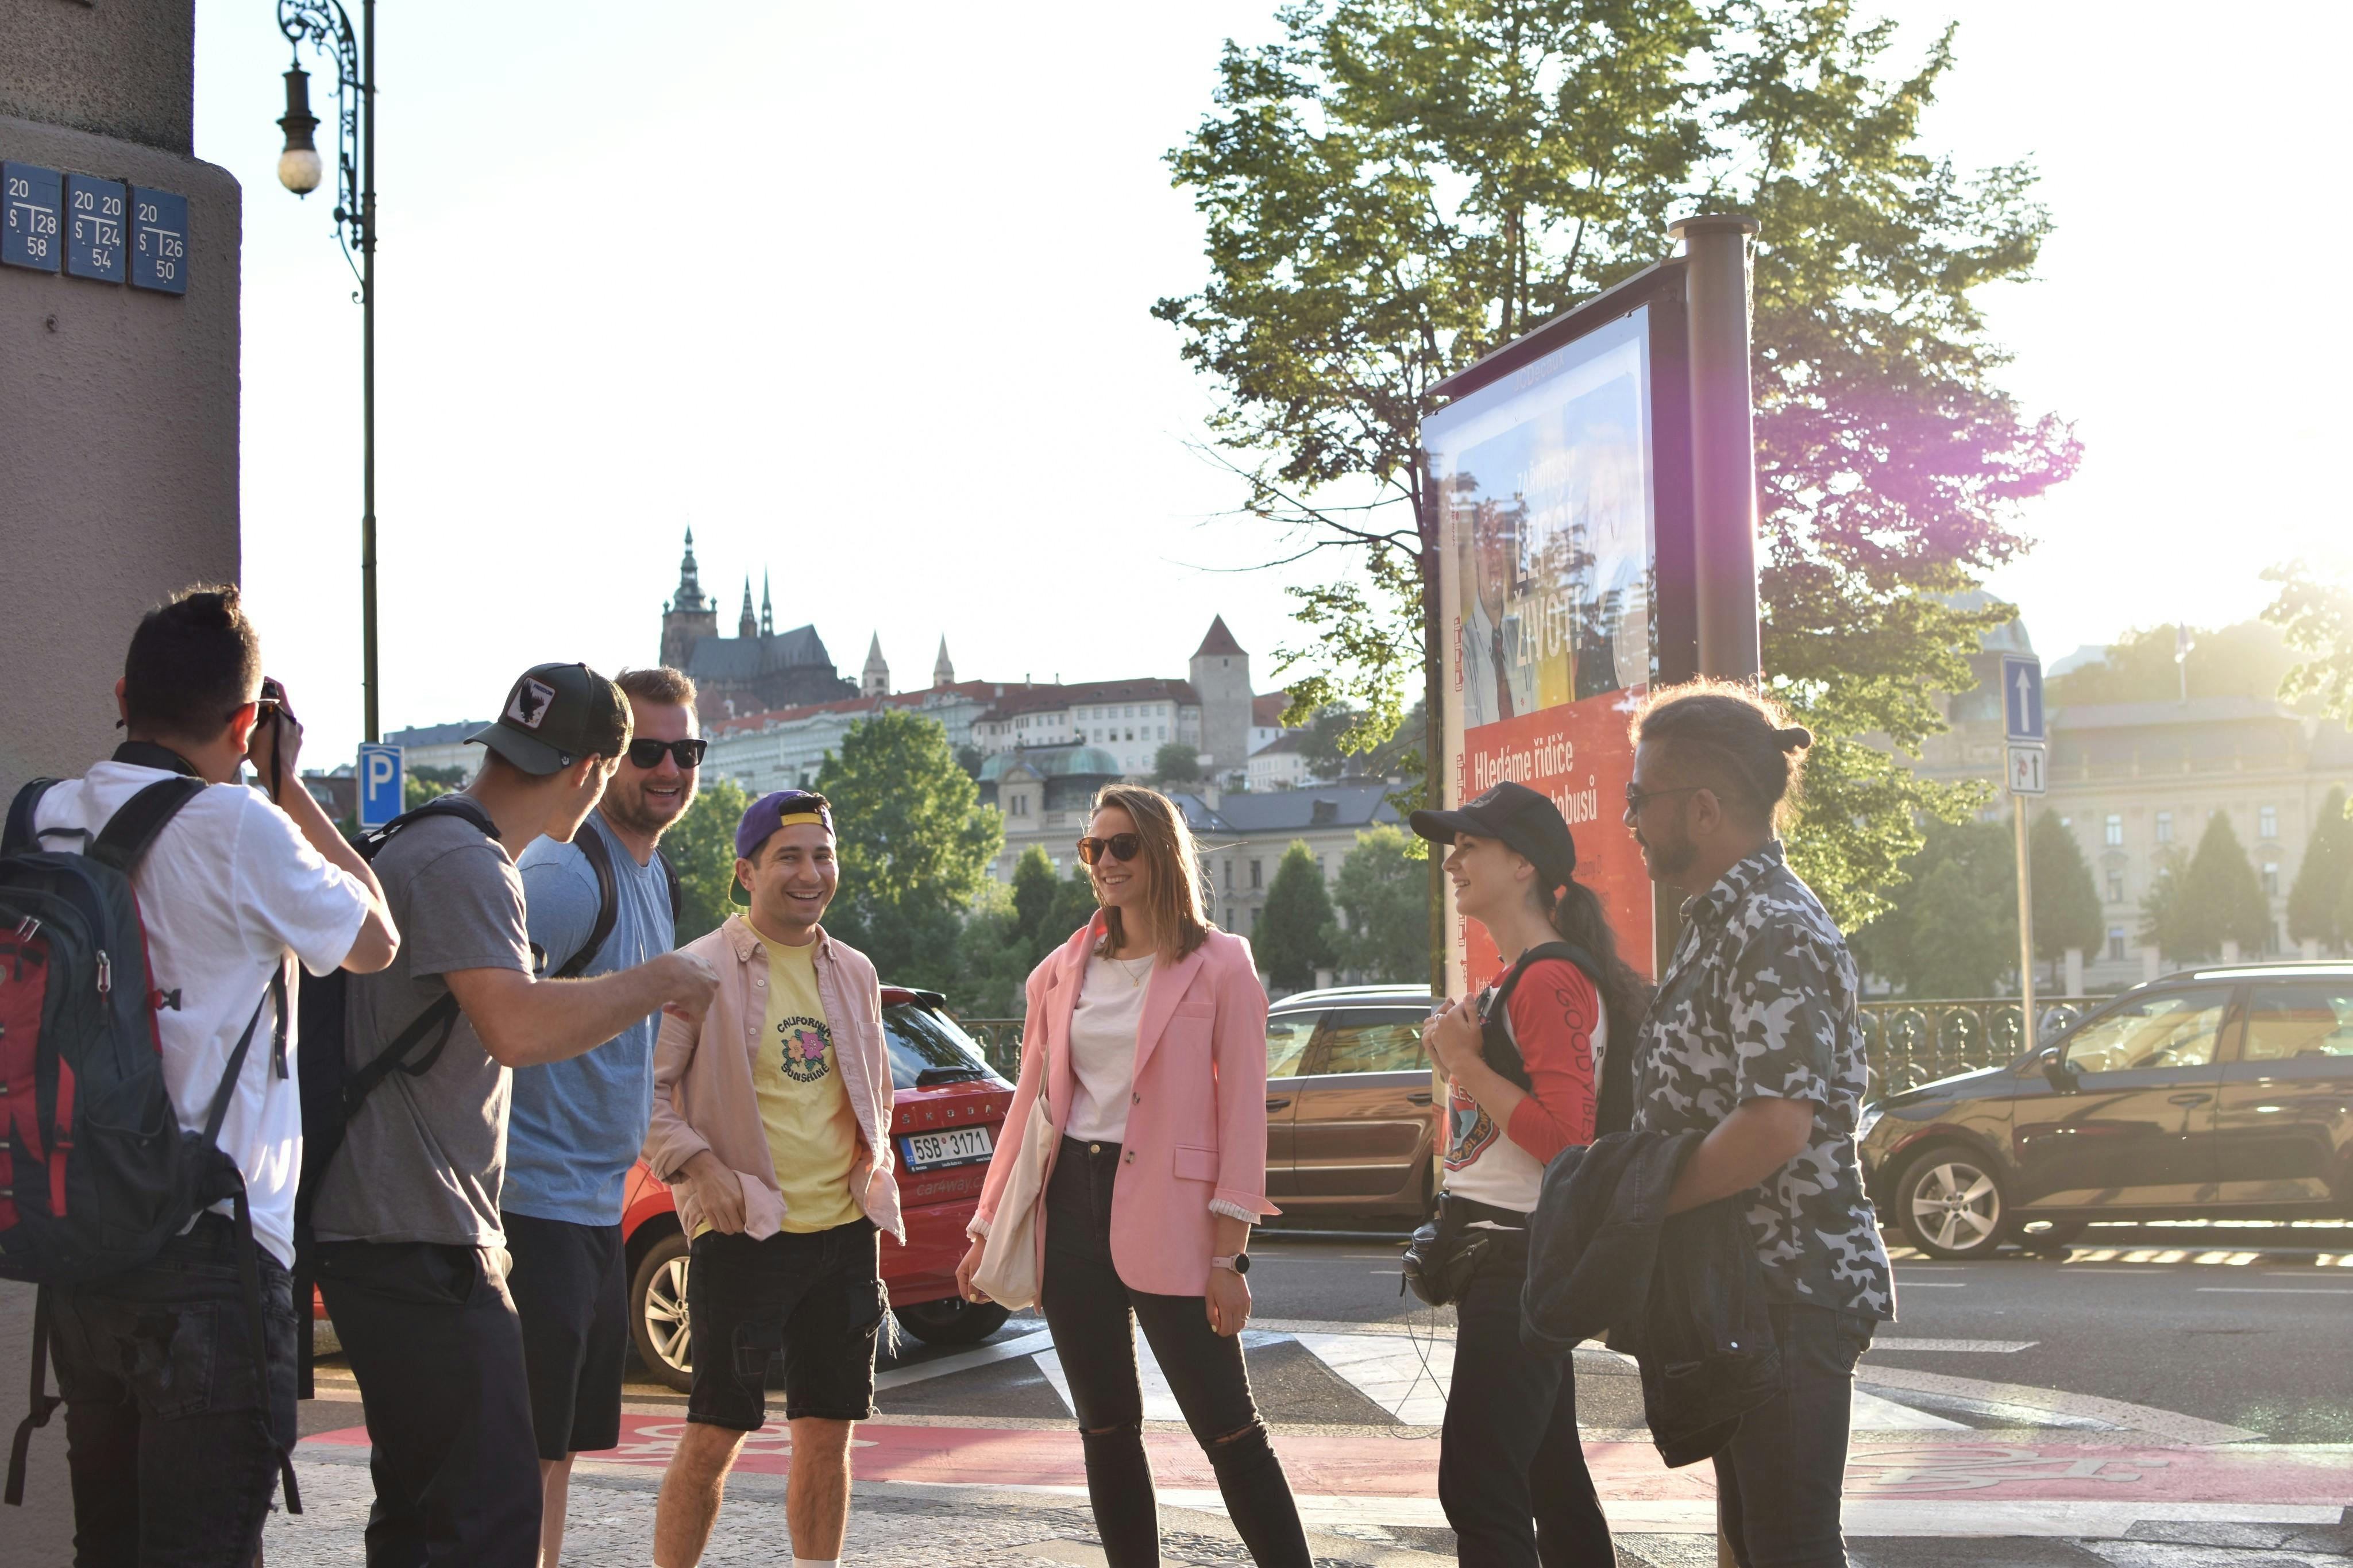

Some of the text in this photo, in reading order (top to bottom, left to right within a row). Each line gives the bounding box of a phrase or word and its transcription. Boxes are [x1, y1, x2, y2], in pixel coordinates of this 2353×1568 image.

[9, 178, 29, 198] 20
[75, 191, 121, 215] 20 20
[139, 203, 157, 222] 20
[9, 209, 56, 234] S 28
[75, 221, 121, 246] S 24
[28, 237, 47, 257] 58
[140, 233, 183, 257] S 26
[92, 248, 111, 268] 54
[156, 260, 175, 279] 50
[1514, 353, 1564, 391] JCDecaux
[1514, 484, 1575, 584] LEPŠÍ
[1514, 586, 1582, 667] ŽIVOT!
[1475, 732, 1573, 791] Hledáme řidiče
[369, 754, 394, 801] P
[1551, 774, 1597, 825] obusů
[1476, 976, 1492, 994] Nabí
[777, 1017, 831, 1037] CALIFORNIA
[781, 1063, 830, 1082] SUNSHINE
[1556, 988, 1595, 1141] GOOD VIBES
[902, 1105, 992, 1124] ŠKODA
[913, 1131, 985, 1160] 5SB 3171
